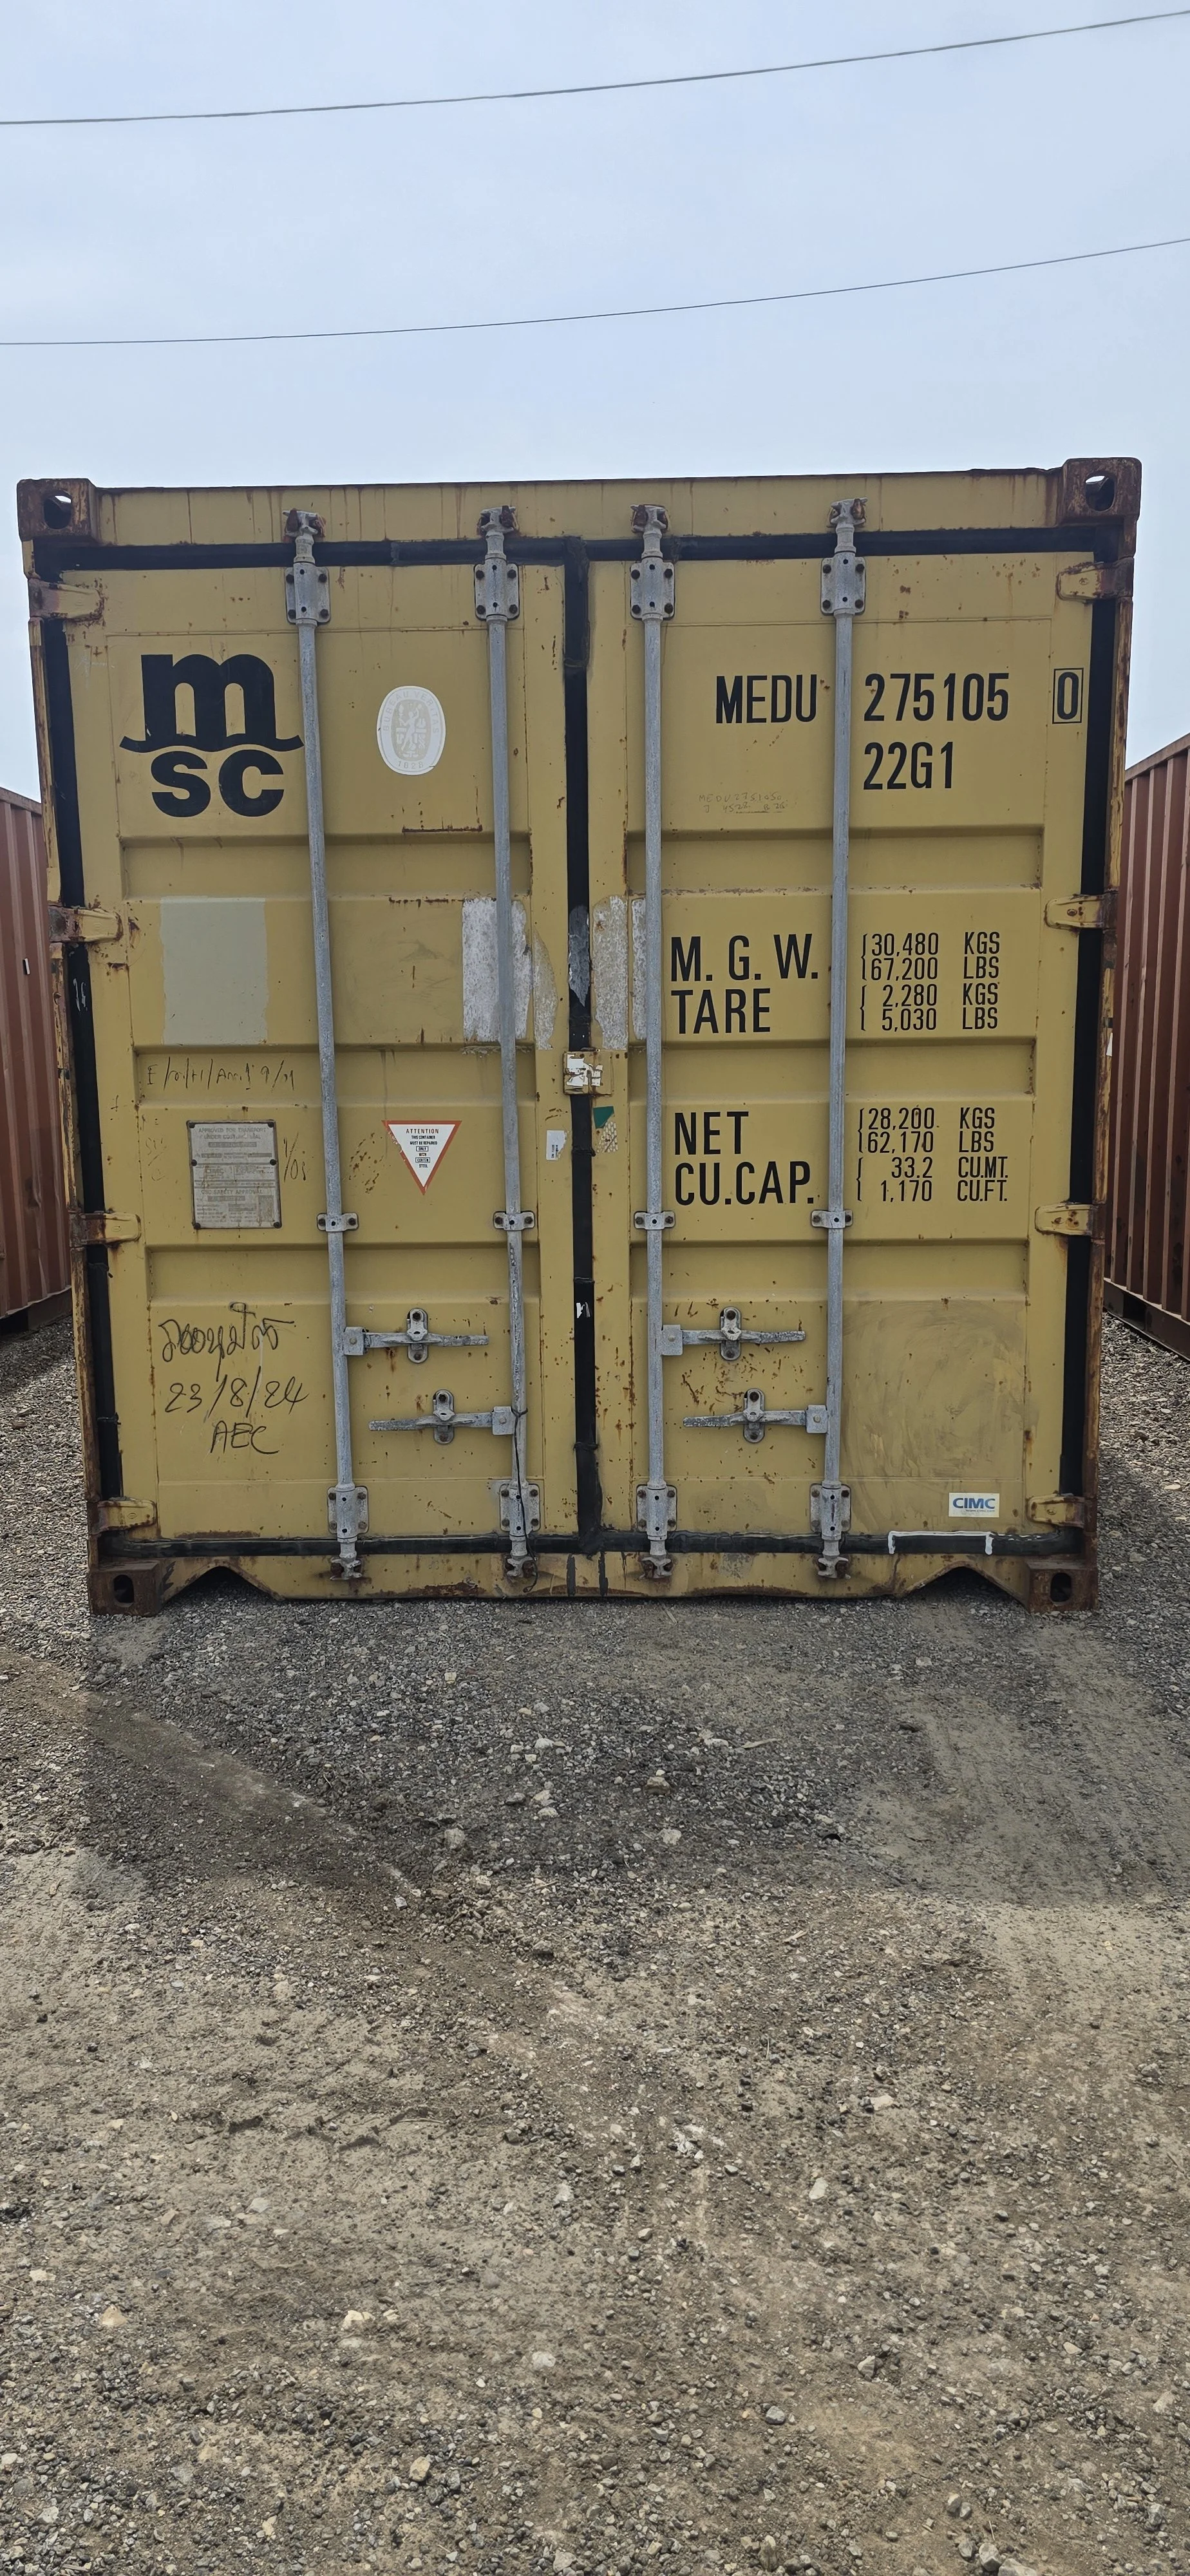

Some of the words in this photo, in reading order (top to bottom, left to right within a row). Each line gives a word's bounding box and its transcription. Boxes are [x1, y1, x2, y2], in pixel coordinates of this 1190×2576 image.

[383, 691, 408, 732] BUREAU
[414, 691, 439, 733] VERITAS
[716, 674, 817, 723] MEDU
[864, 673, 1009, 721] 275105
[1057, 672, 1079, 720] 0
[398, 761, 424, 770] 1828
[864, 742, 952, 790] 22G1
[672, 936, 712, 981] M.
[729, 936, 760, 980] G.
[773, 934, 818, 979] W.
[872, 933, 938, 956] 30,480
[965, 932, 999, 954] KGS
[871, 957, 938, 980] 67,200
[964, 956, 999, 979] LBS
[671, 988, 770, 1034] TARE
[883, 984, 937, 1007] 2,280
[963, 983, 997, 1005] KGS
[882, 1008, 936, 1030] 5,030
[963, 1007, 997, 1029] LBS
[675, 1112, 749, 1155] NET
[869, 1108, 934, 1130] 28,200
[960, 1108, 994, 1129] KGS
[868, 1132, 933, 1153] 62,170
[959, 1131, 994, 1152] LBS
[675, 1161, 813, 1206] CU.CAP.
[892, 1157, 932, 1178] 33.2
[959, 1157, 1008, 1178] CU.MT.
[882, 1180, 932, 1201] 1,170
[958, 1180, 1006, 1201] CU.FT.
[165, 1366, 309, 1418] 23/8/24
[211, 1421, 279, 1454] AEC
[953, 1498, 995, 1509] CIMC
